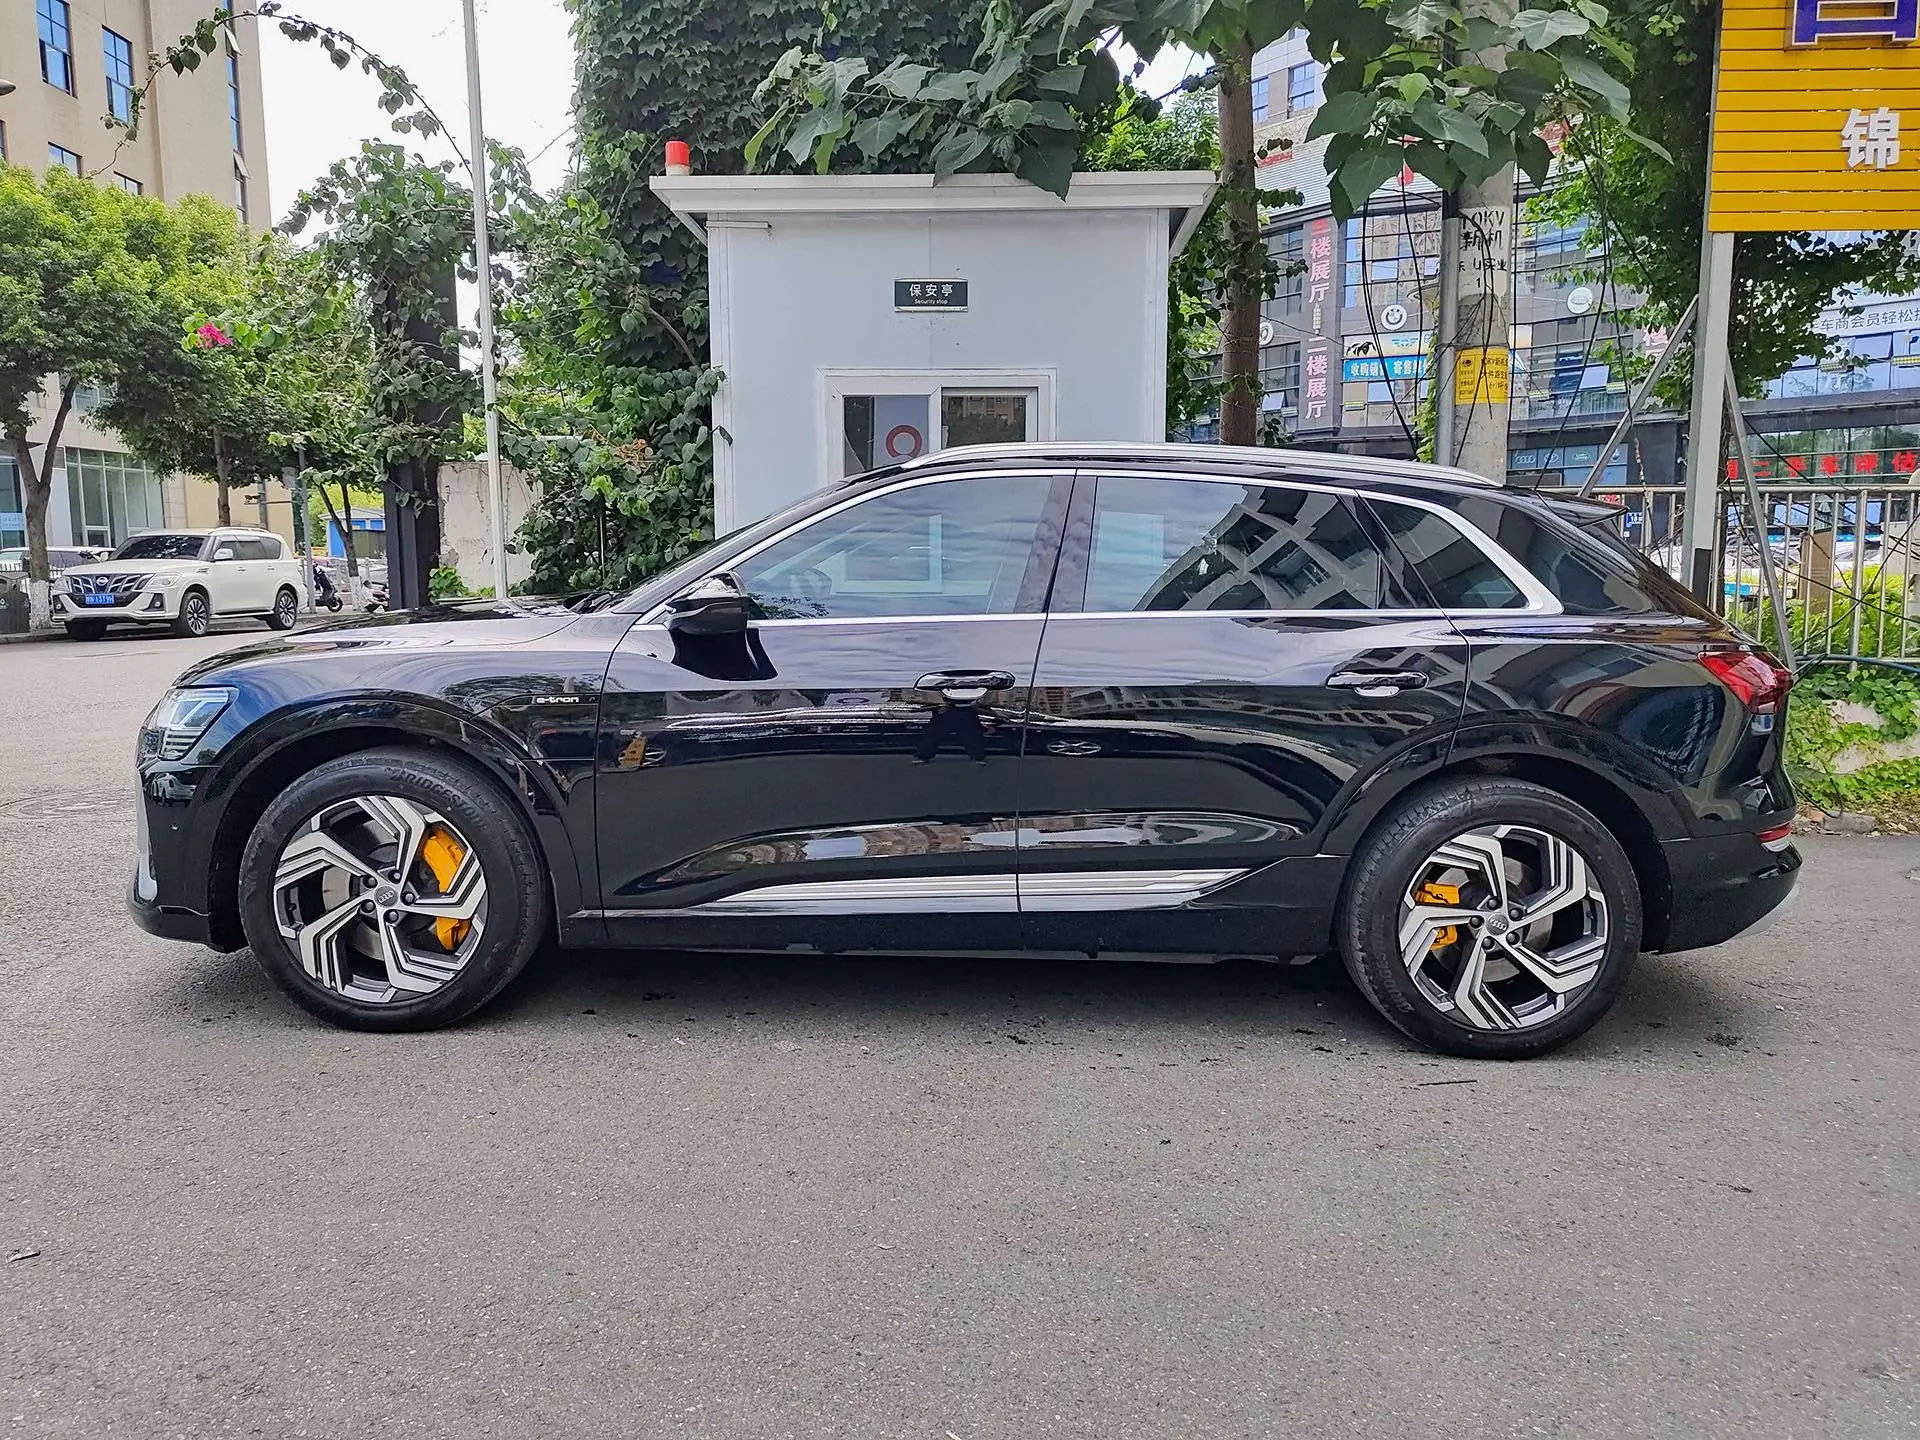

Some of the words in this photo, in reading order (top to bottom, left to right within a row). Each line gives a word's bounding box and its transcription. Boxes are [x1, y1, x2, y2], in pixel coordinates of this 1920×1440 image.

[1840, 107, 1900, 169] 锦
[909, 283, 953, 297] 保安亭
[1304, 336, 1328, 420] 二楼展厅
[536, 696, 580, 704] e-tron
